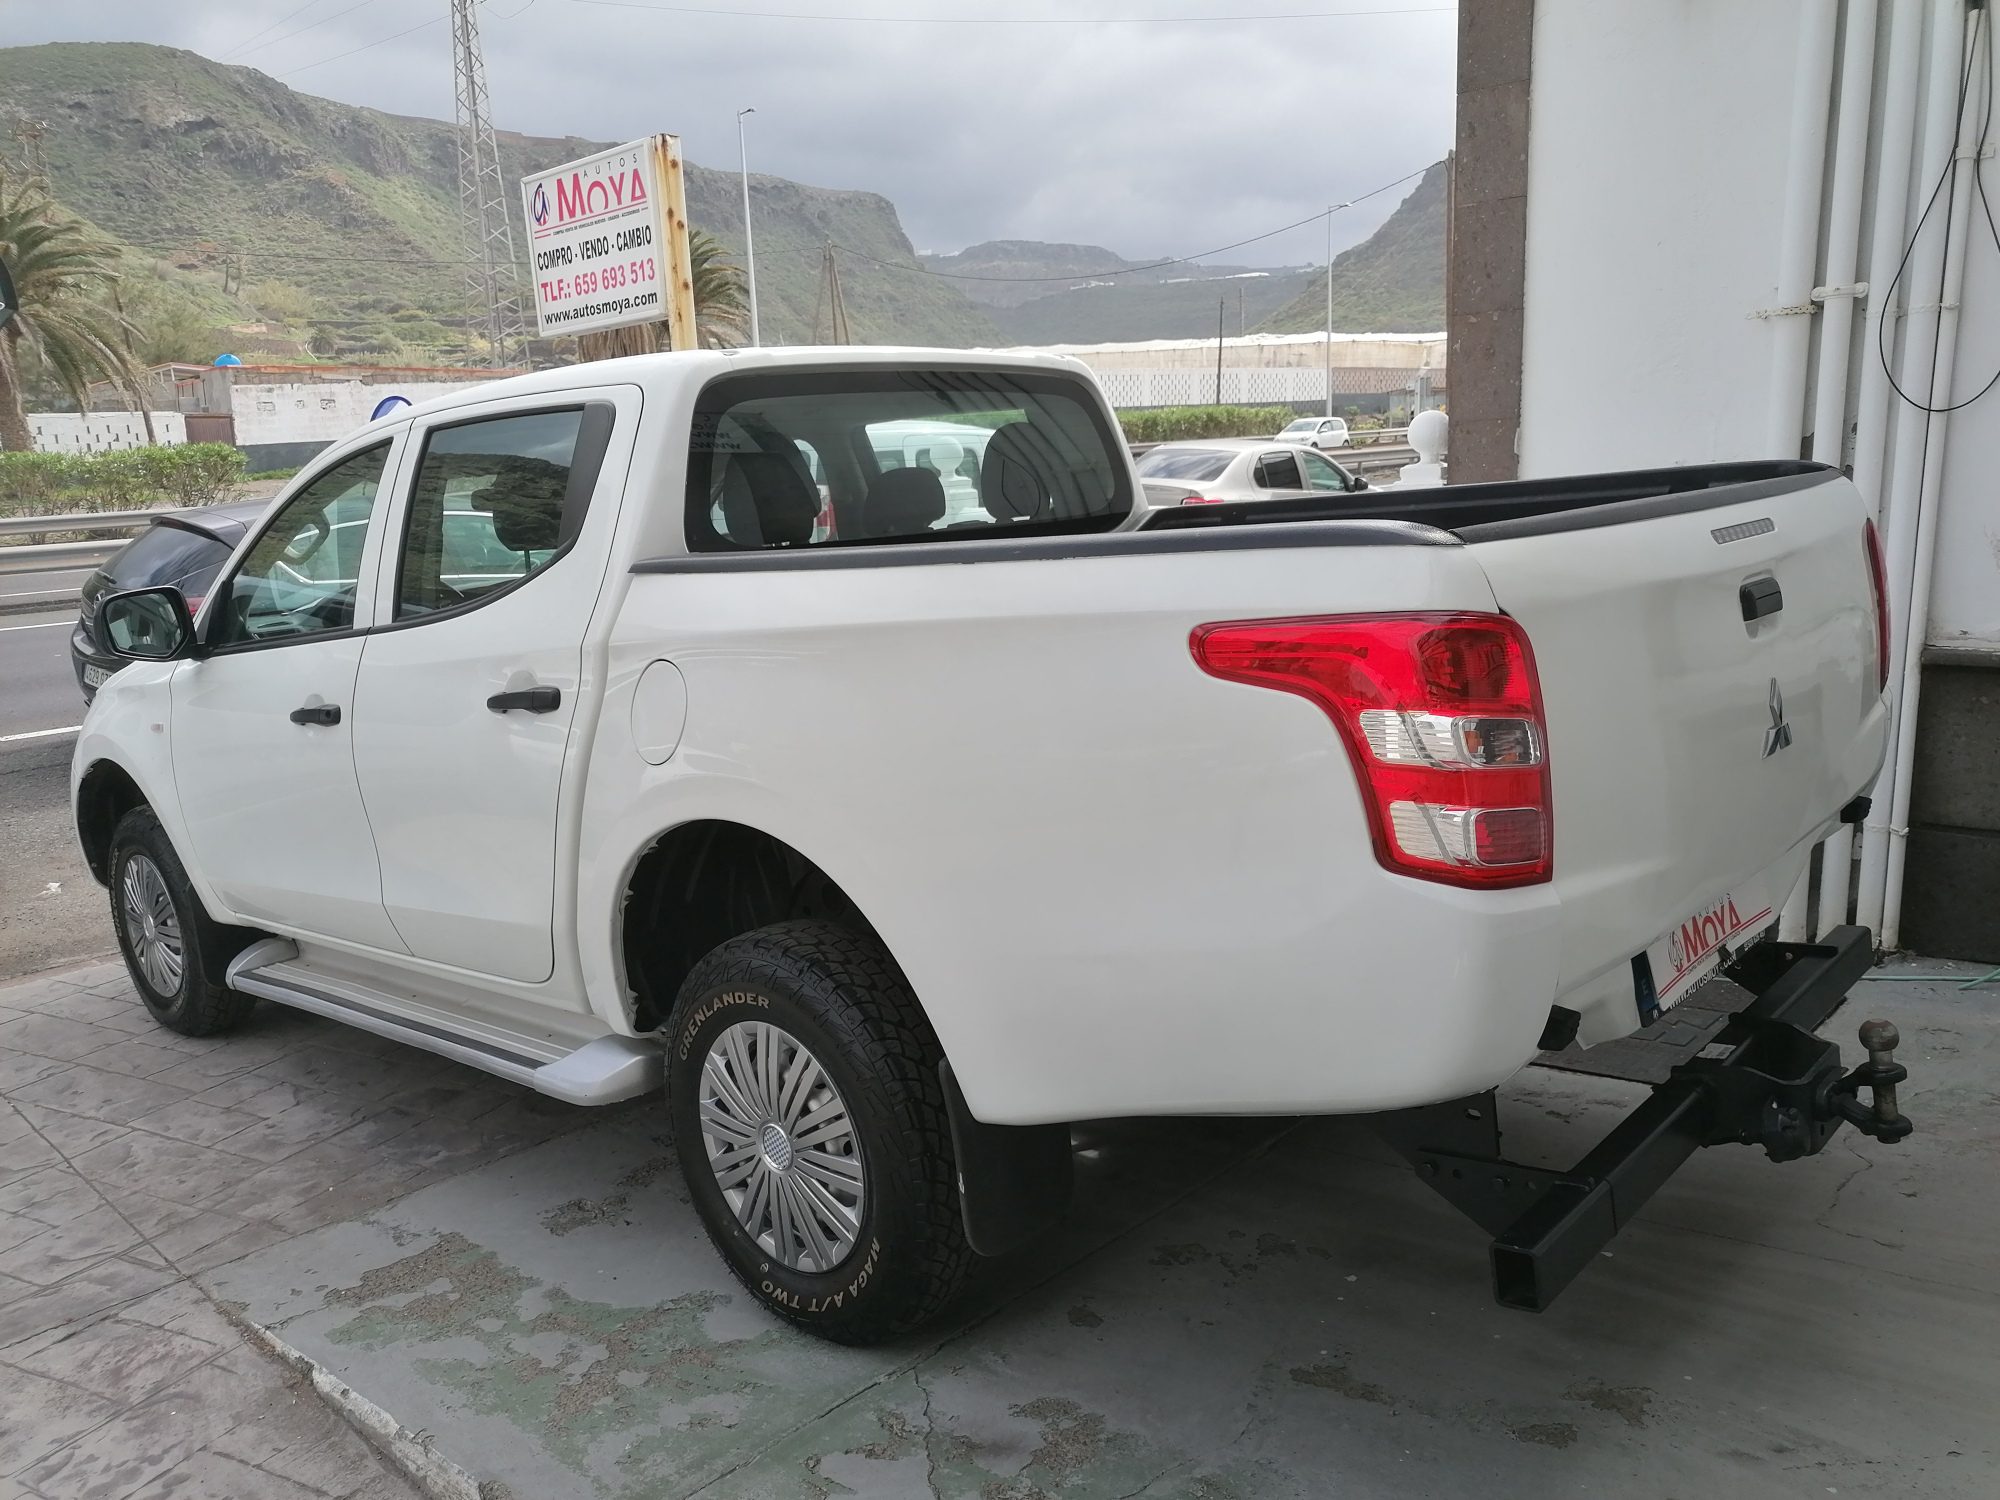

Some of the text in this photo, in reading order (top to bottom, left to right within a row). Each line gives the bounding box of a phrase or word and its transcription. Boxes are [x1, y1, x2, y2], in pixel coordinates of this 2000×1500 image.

[583, 153, 638, 178] AUTOS
[537, 245, 573, 271] COMPRO
[578, 236, 609, 261] VENDO
[616, 225, 652, 252] CAMBIO
[540, 257, 655, 302] TLF.: 659 693 513
[544, 291, 658, 325] www.autosmoya.com
[1681, 900, 1742, 963] MOYA
[680, 991, 770, 1061] GRENLANDER
[761, 1280, 800, 1309] TWO
[807, 1290, 844, 1313] A/T
